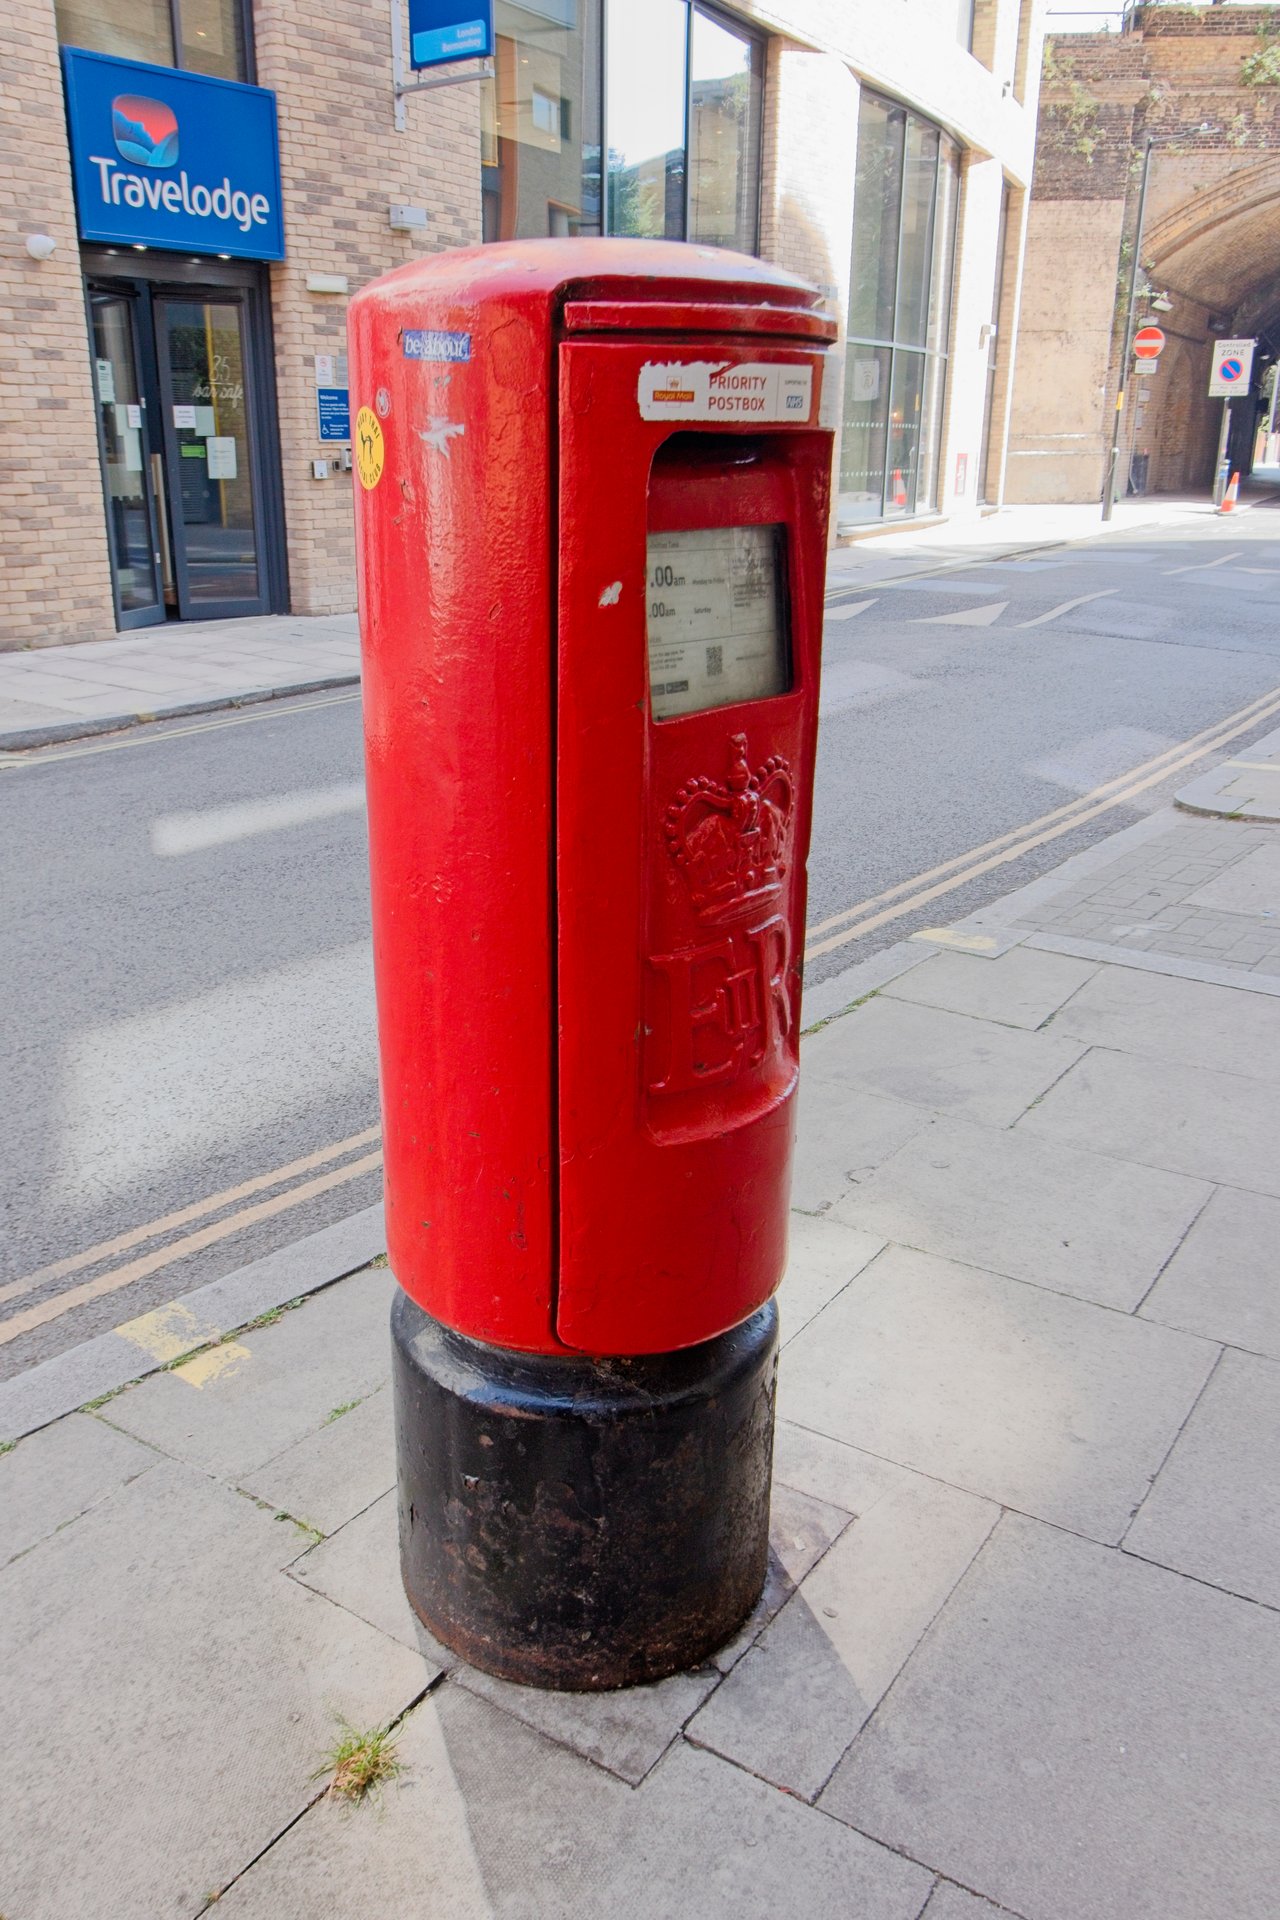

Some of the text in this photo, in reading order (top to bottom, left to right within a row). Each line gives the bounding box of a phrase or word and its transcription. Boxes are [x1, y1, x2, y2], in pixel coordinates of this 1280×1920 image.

[88, 155, 271, 233] Travelodge
[1221, 349, 1245, 357] ZONE
[708, 375, 767, 391] PRIORITY
[655, 390, 693, 401] Royal Mail
[786, 395, 803, 409] NHS
[707, 396, 766, 412] POSTBOX
